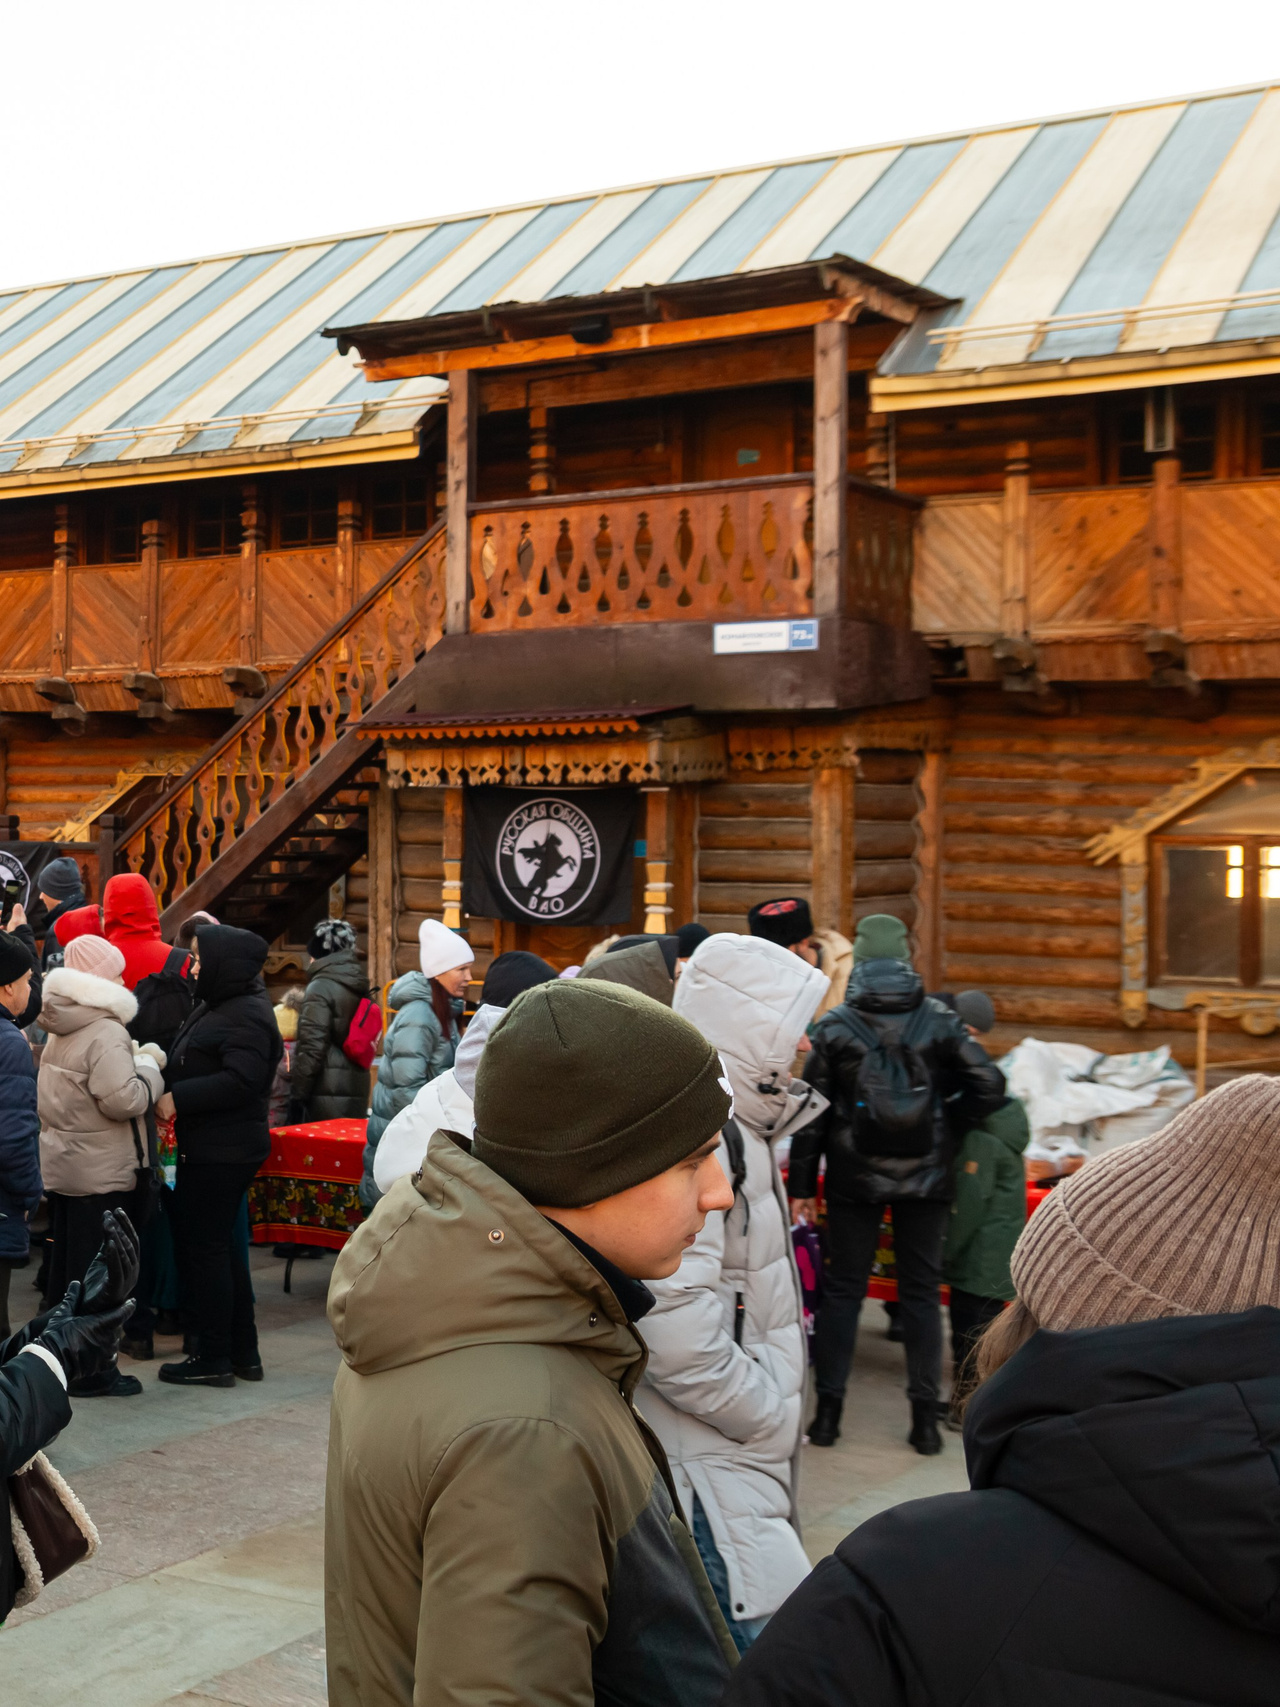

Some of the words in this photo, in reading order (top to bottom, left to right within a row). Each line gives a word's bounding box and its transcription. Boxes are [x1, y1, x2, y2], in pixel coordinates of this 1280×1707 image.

[502, 803, 547, 856] РУССКАЯ
[549, 803, 596, 859] ОБЩИНА
[528, 895, 565, 913] ВАО
